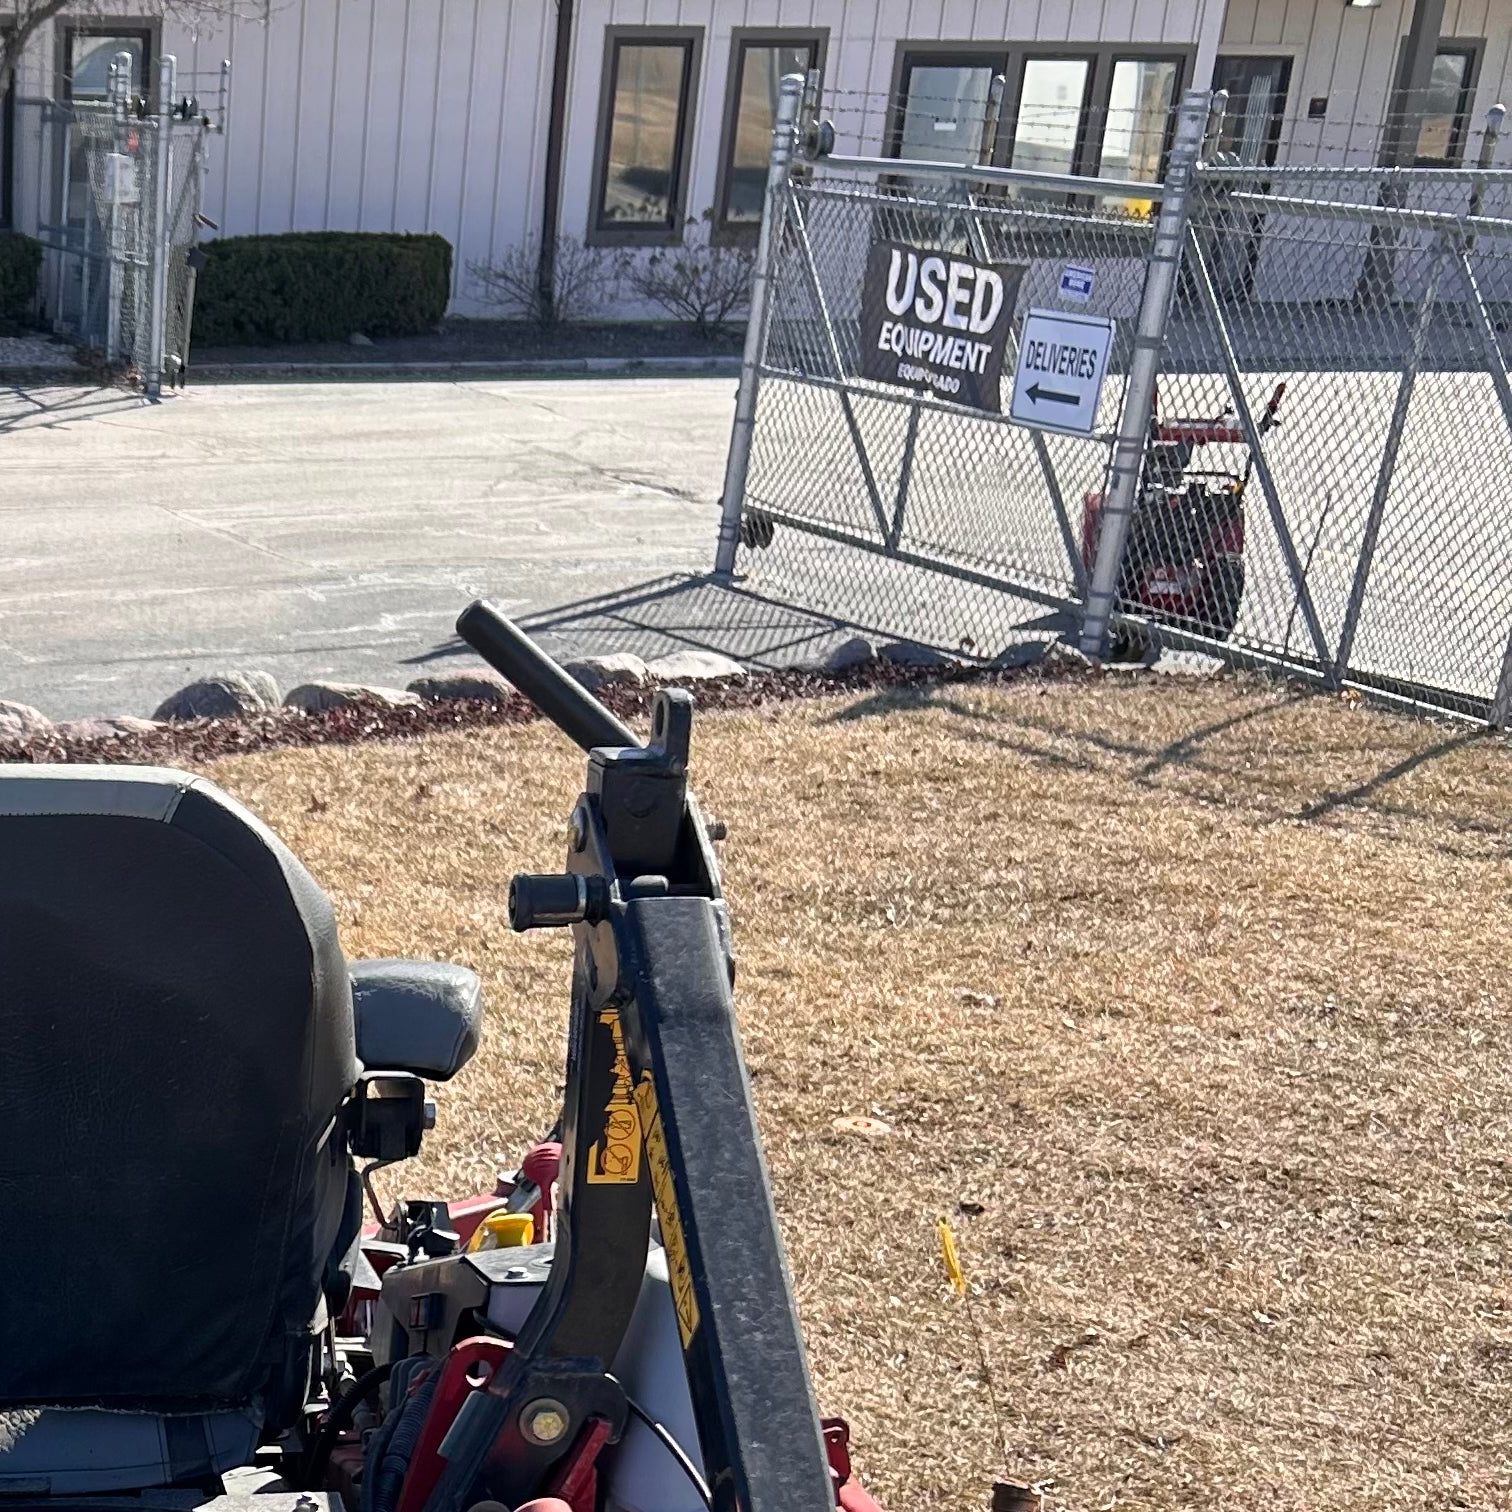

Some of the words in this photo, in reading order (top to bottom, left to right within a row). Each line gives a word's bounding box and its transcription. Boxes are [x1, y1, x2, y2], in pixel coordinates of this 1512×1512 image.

[886, 249, 1003, 334] USED
[878, 321, 992, 374] EQUIPMENT
[1026, 340, 1097, 380] DELIVERIES
